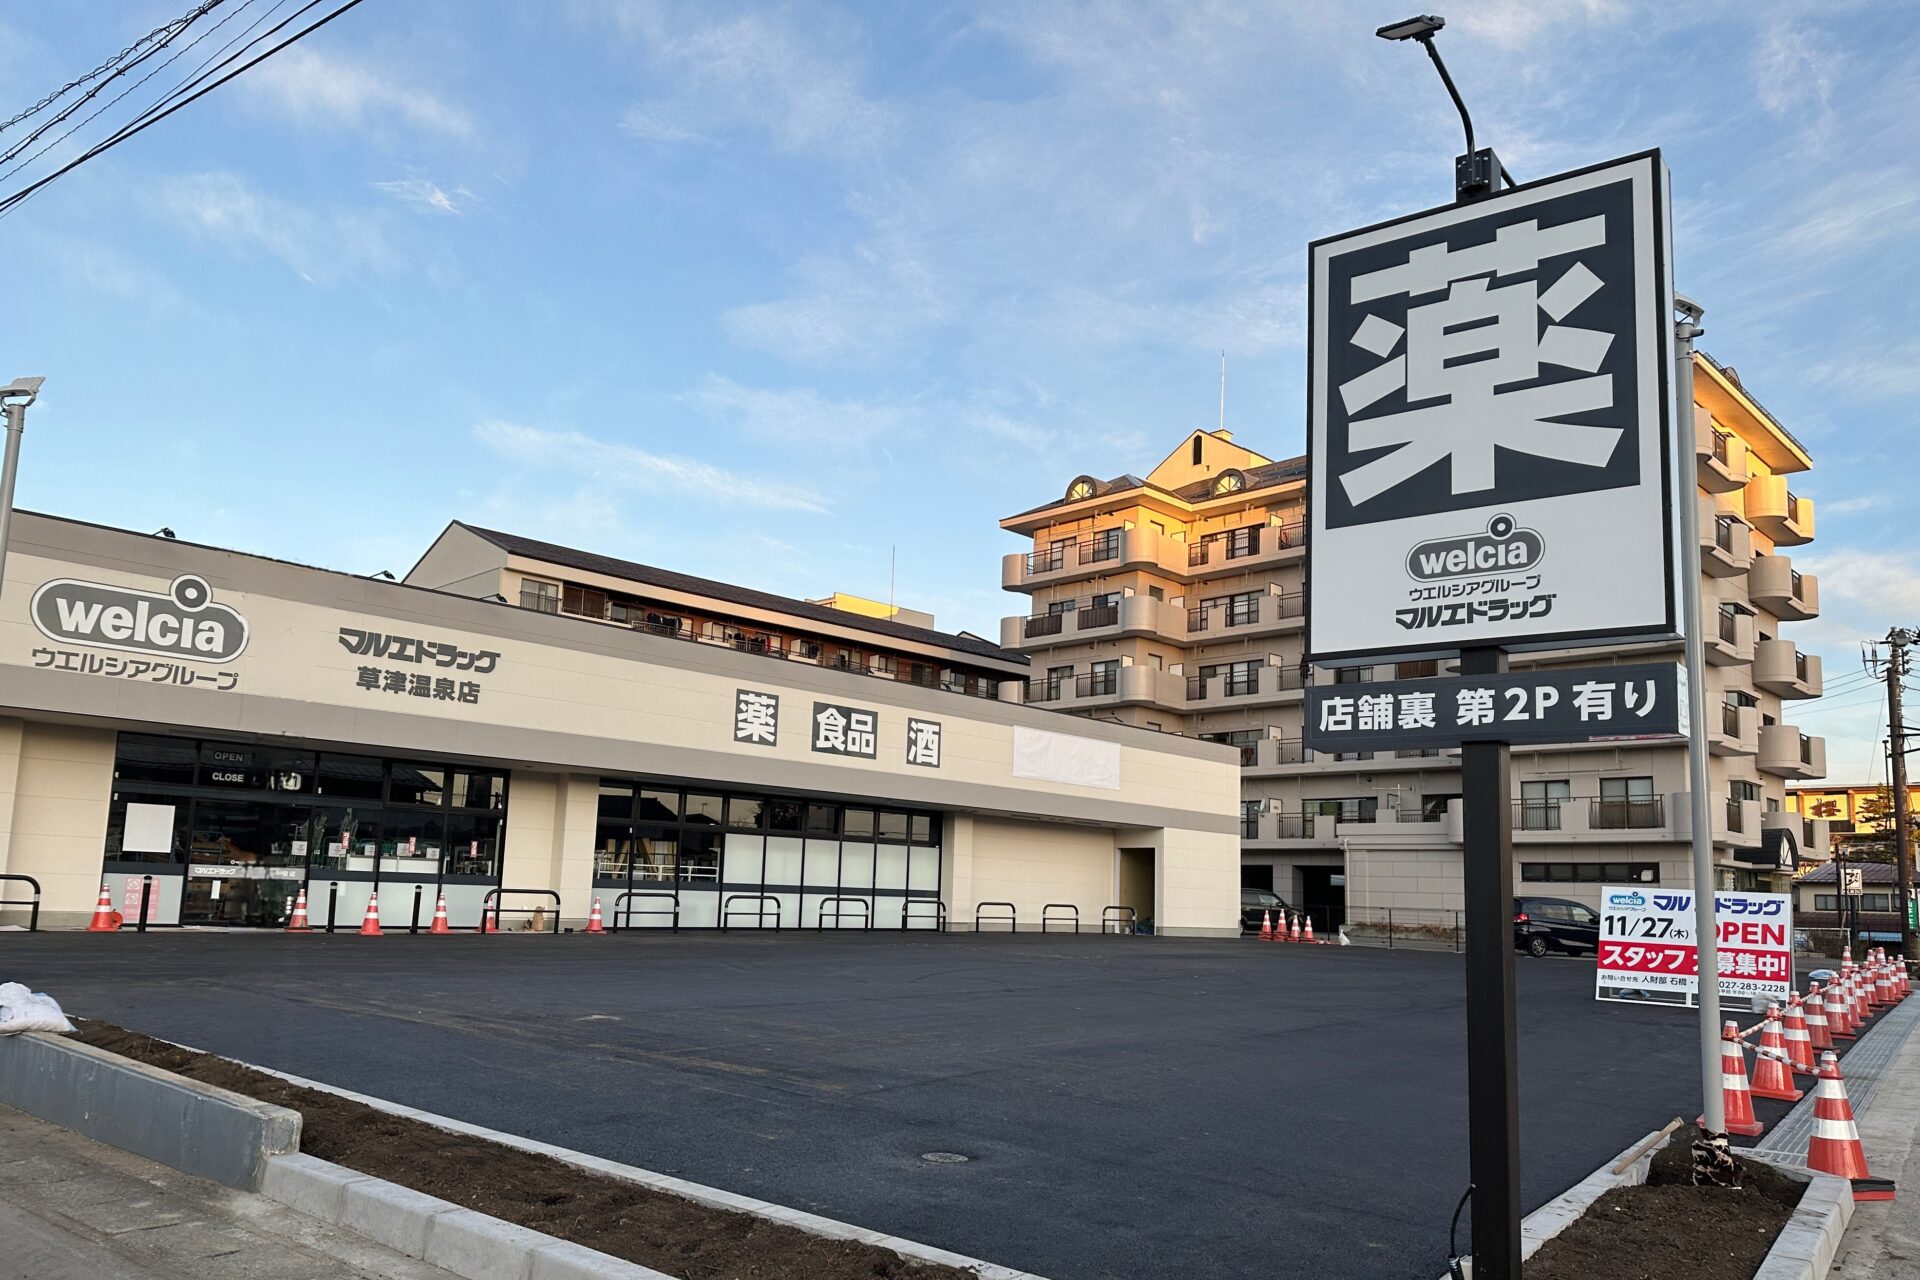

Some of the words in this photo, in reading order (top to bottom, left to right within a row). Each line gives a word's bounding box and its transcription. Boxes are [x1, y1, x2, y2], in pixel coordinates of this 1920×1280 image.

[1339, 214, 1624, 507] 薬
[1419, 518, 1528, 575] welcia
[1409, 574, 1541, 601] ウエルシアグループ
[56, 579, 225, 653] welcia
[1396, 594, 1557, 630] マルエドラッグ
[339, 627, 501, 673] マルエドラッグ
[32, 648, 239, 691] ウエルシアグループ
[356, 666, 480, 704] 草津温泉店
[1319, 692, 1436, 732] 店舗裏
[1456, 686, 1560, 726] 第2P
[1572, 680, 1656, 721] 有り
[736, 693, 776, 742] 薬
[816, 708, 875, 754] 食品
[908, 720, 939, 765] 酒
[214, 752, 244, 761] OPEN
[212, 772, 244, 782] CLOSE
[1612, 894, 1643, 905] welcia
[1653, 895, 1785, 916] マルドラッグ
[1715, 921, 1785, 946] PEN
[1719, 981, 1785, 992] 027-283-2228
